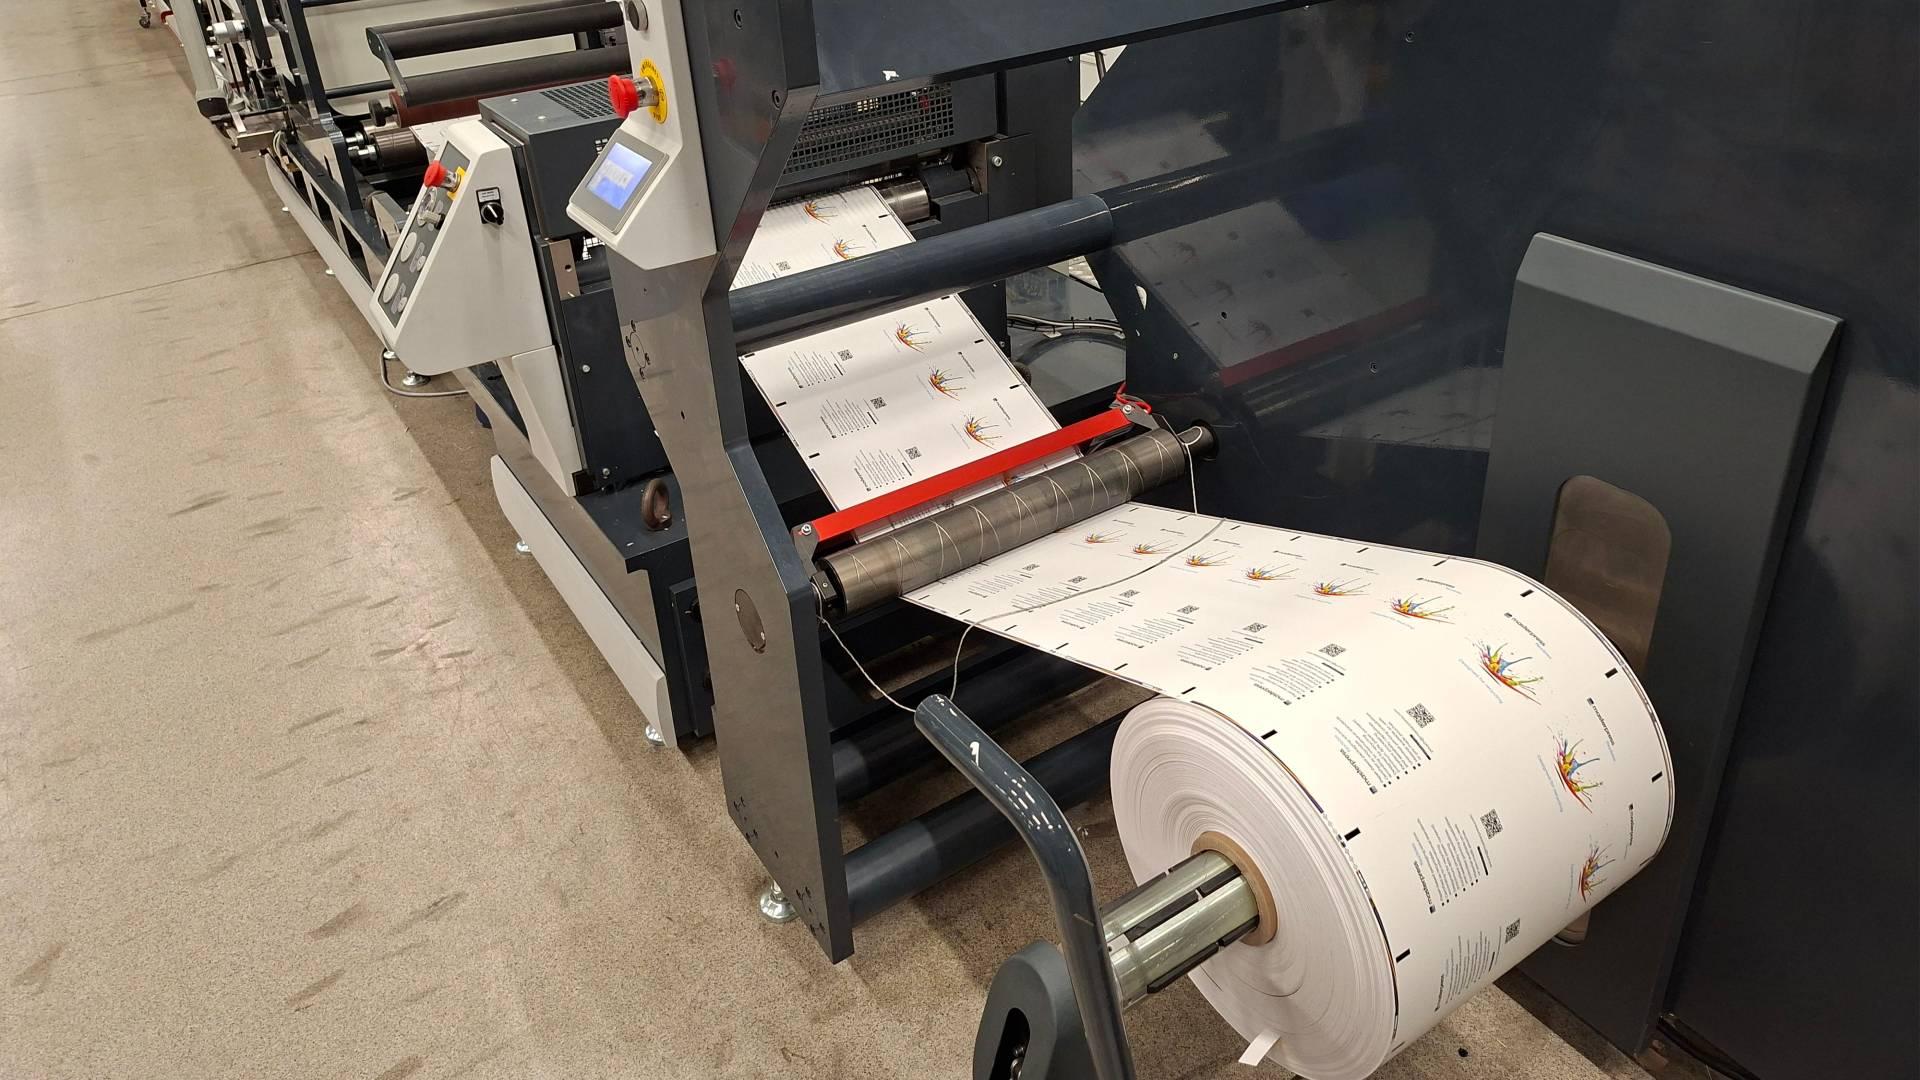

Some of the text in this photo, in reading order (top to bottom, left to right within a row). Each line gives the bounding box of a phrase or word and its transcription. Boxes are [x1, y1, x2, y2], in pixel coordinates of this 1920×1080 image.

[1590, 704, 1617, 746] masterpress
[1338, 747, 1372, 786] masterpress
[1412, 859, 1433, 905] masterpress
